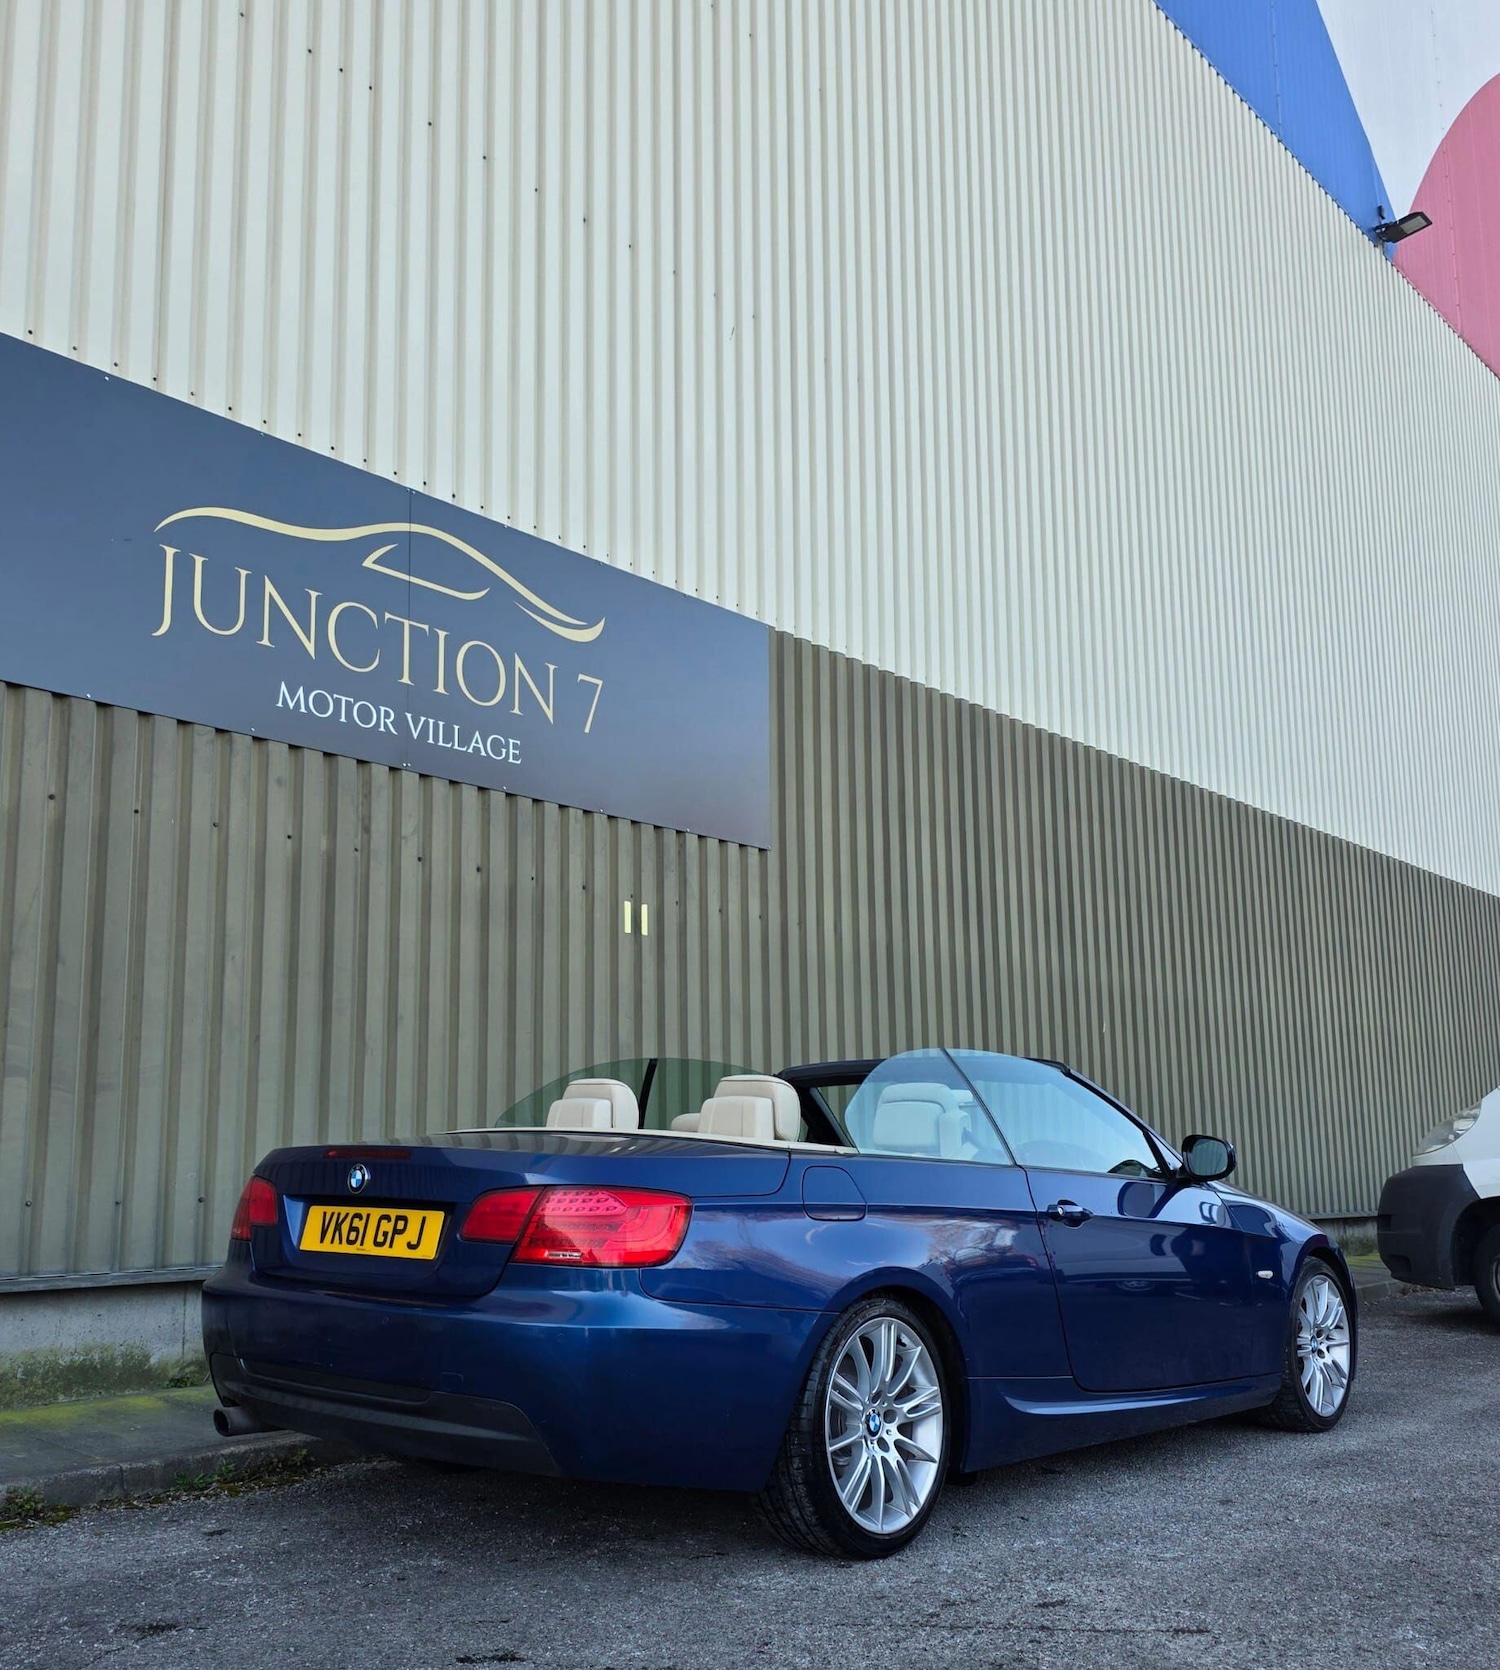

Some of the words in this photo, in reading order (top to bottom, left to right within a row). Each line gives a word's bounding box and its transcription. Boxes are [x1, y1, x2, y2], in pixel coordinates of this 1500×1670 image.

[151, 544, 558, 725] JUNCTION
[576, 673, 604, 734] 7
[275, 680, 398, 735] MOTOR
[405, 712, 522, 764] VILLAGE
[319, 1211, 371, 1247] VK61
[373, 1213, 427, 1250] GPJ
